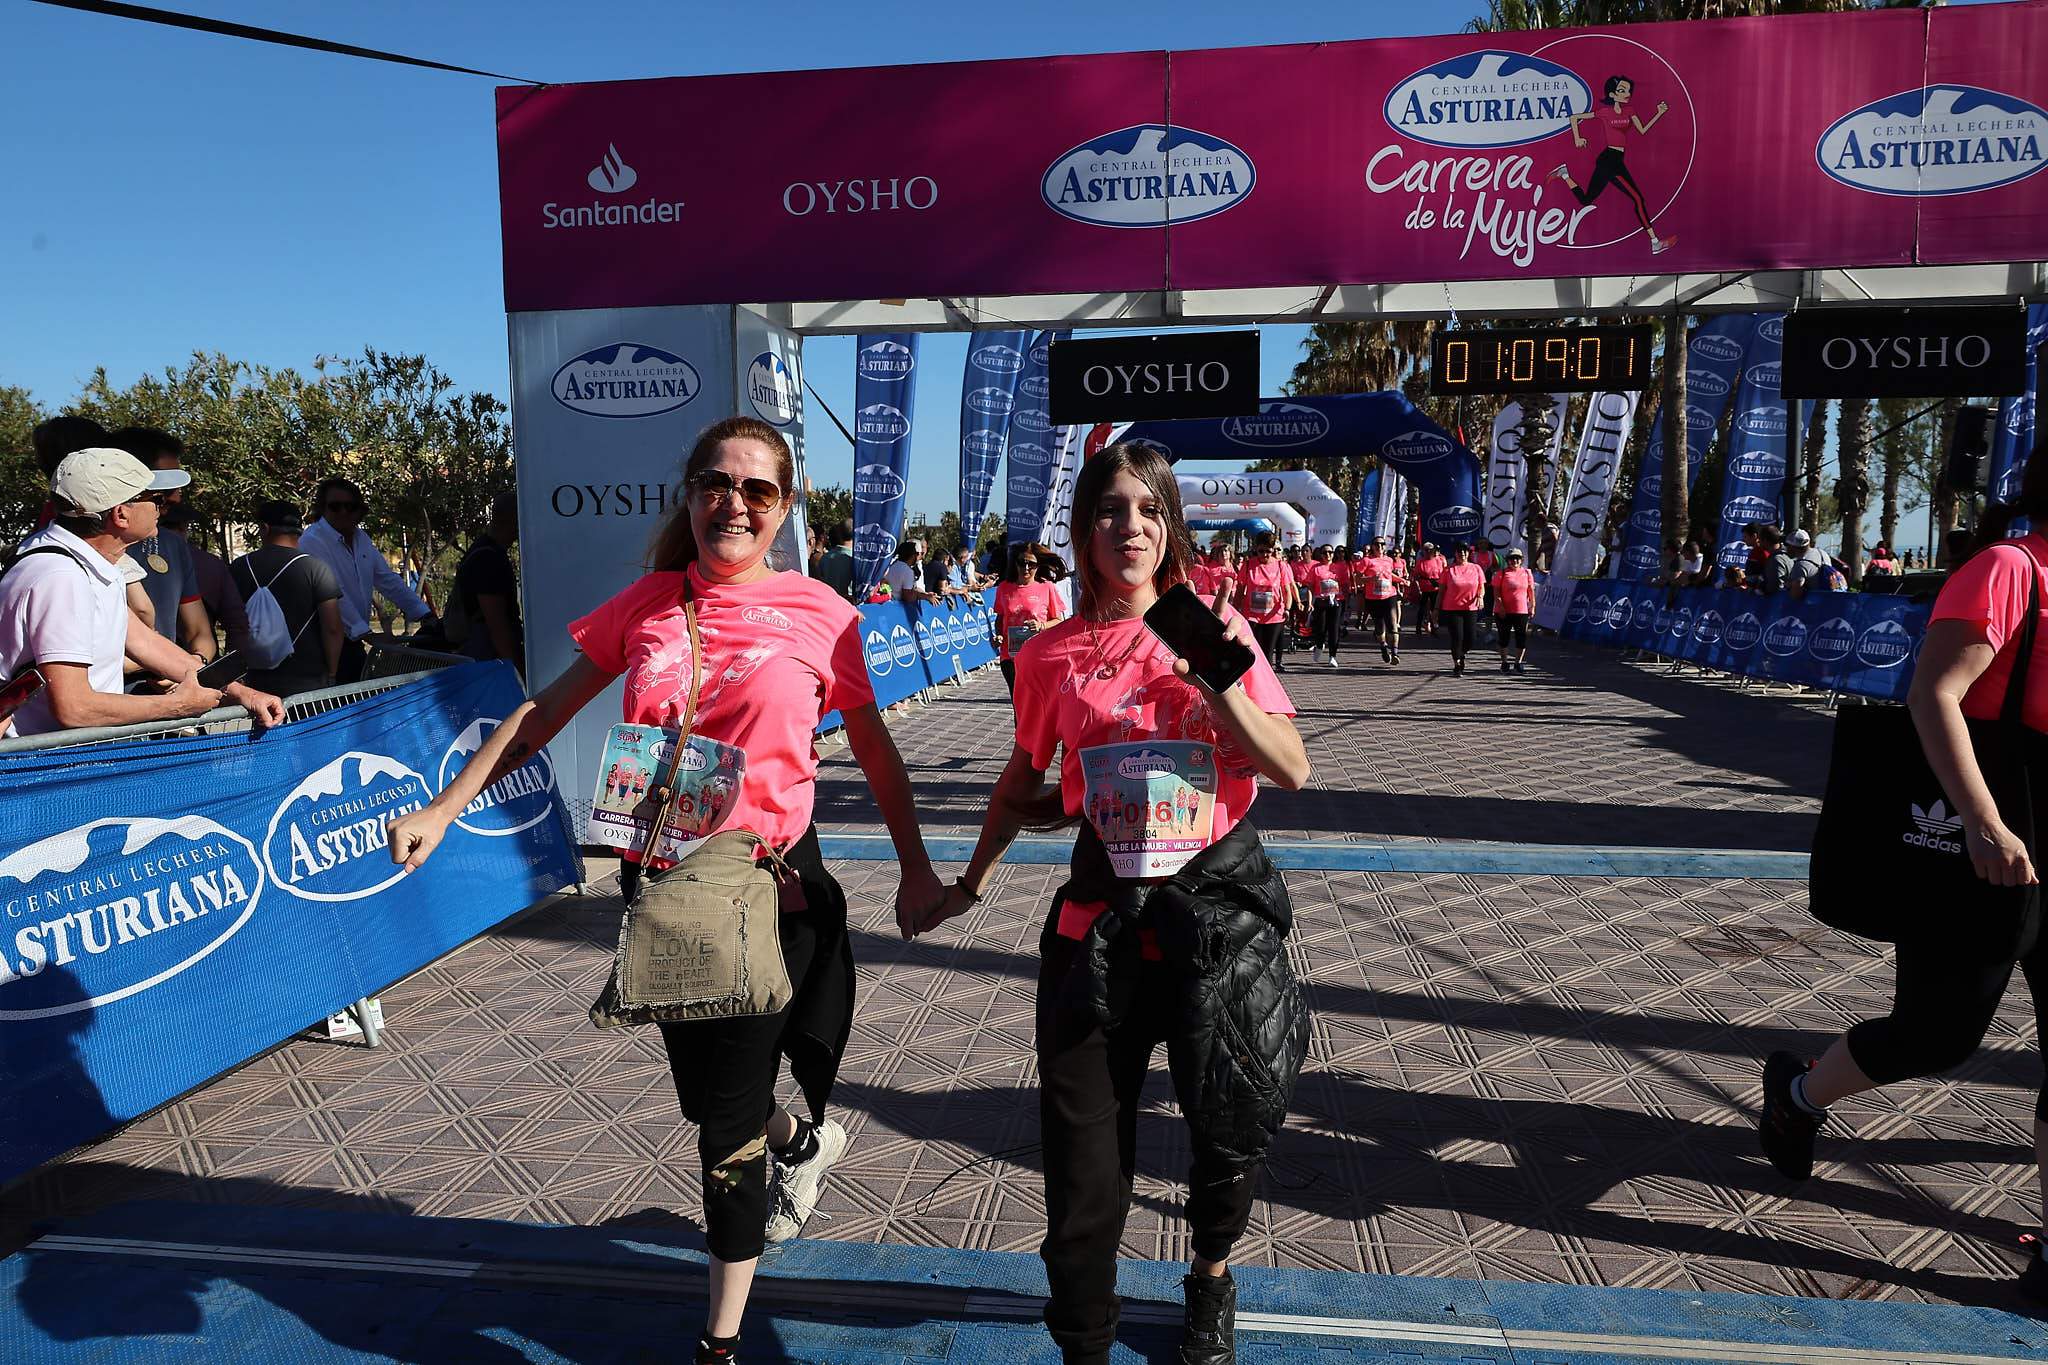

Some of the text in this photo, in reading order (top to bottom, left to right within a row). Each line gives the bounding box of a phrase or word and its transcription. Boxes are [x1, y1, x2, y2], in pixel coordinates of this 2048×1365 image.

[1432, 80, 1570, 96] CENTRAL LECHERA
[1400, 89, 1575, 126] ASTURIANA
[1873, 119, 2036, 137] CENTRAL LECHERA
[1834, 129, 2043, 170] ASTURIANA
[1090, 160, 1157, 173] CENTRAL
[1364, 144, 1534, 194] Carrera
[1057, 166, 1239, 204] ASTURIANA
[783, 176, 939, 217] OYSHO
[543, 198, 684, 229] Santander
[1405, 185, 1597, 268] de la Mujer
[1822, 335, 1991, 370] OYSHO
[584, 367, 685, 378] CENTRAL LECHERA
[1083, 361, 1230, 396] OYSHO
[563, 372, 690, 401] ASTURIANA
[1230, 417, 1321, 436] ASTURIANA
[1389, 444, 1449, 457] ASTURIANA
[1566, 392, 1631, 539] OYSHO
[1202, 477, 1285, 496] OYSHO
[744, 611, 790, 629] ASTURIANA
[1191, 751, 1204, 761] 20
[1121, 762, 1172, 775] ASTURIANA
[311, 781, 418, 826] CENTRAL LECHERA
[599, 812, 635, 826] CARRERA
[1120, 842, 1129, 852] DE
[1131, 842, 1140, 851] LA
[1142, 841, 1168, 851] MUJER
[1902, 832, 1961, 854] adidas
[6, 842, 230, 918] CENTRAL LECHERA
[650, 937, 714, 957] LOVE
[648, 958, 696, 969] PRODUCT
[648, 970, 670, 981] THE
